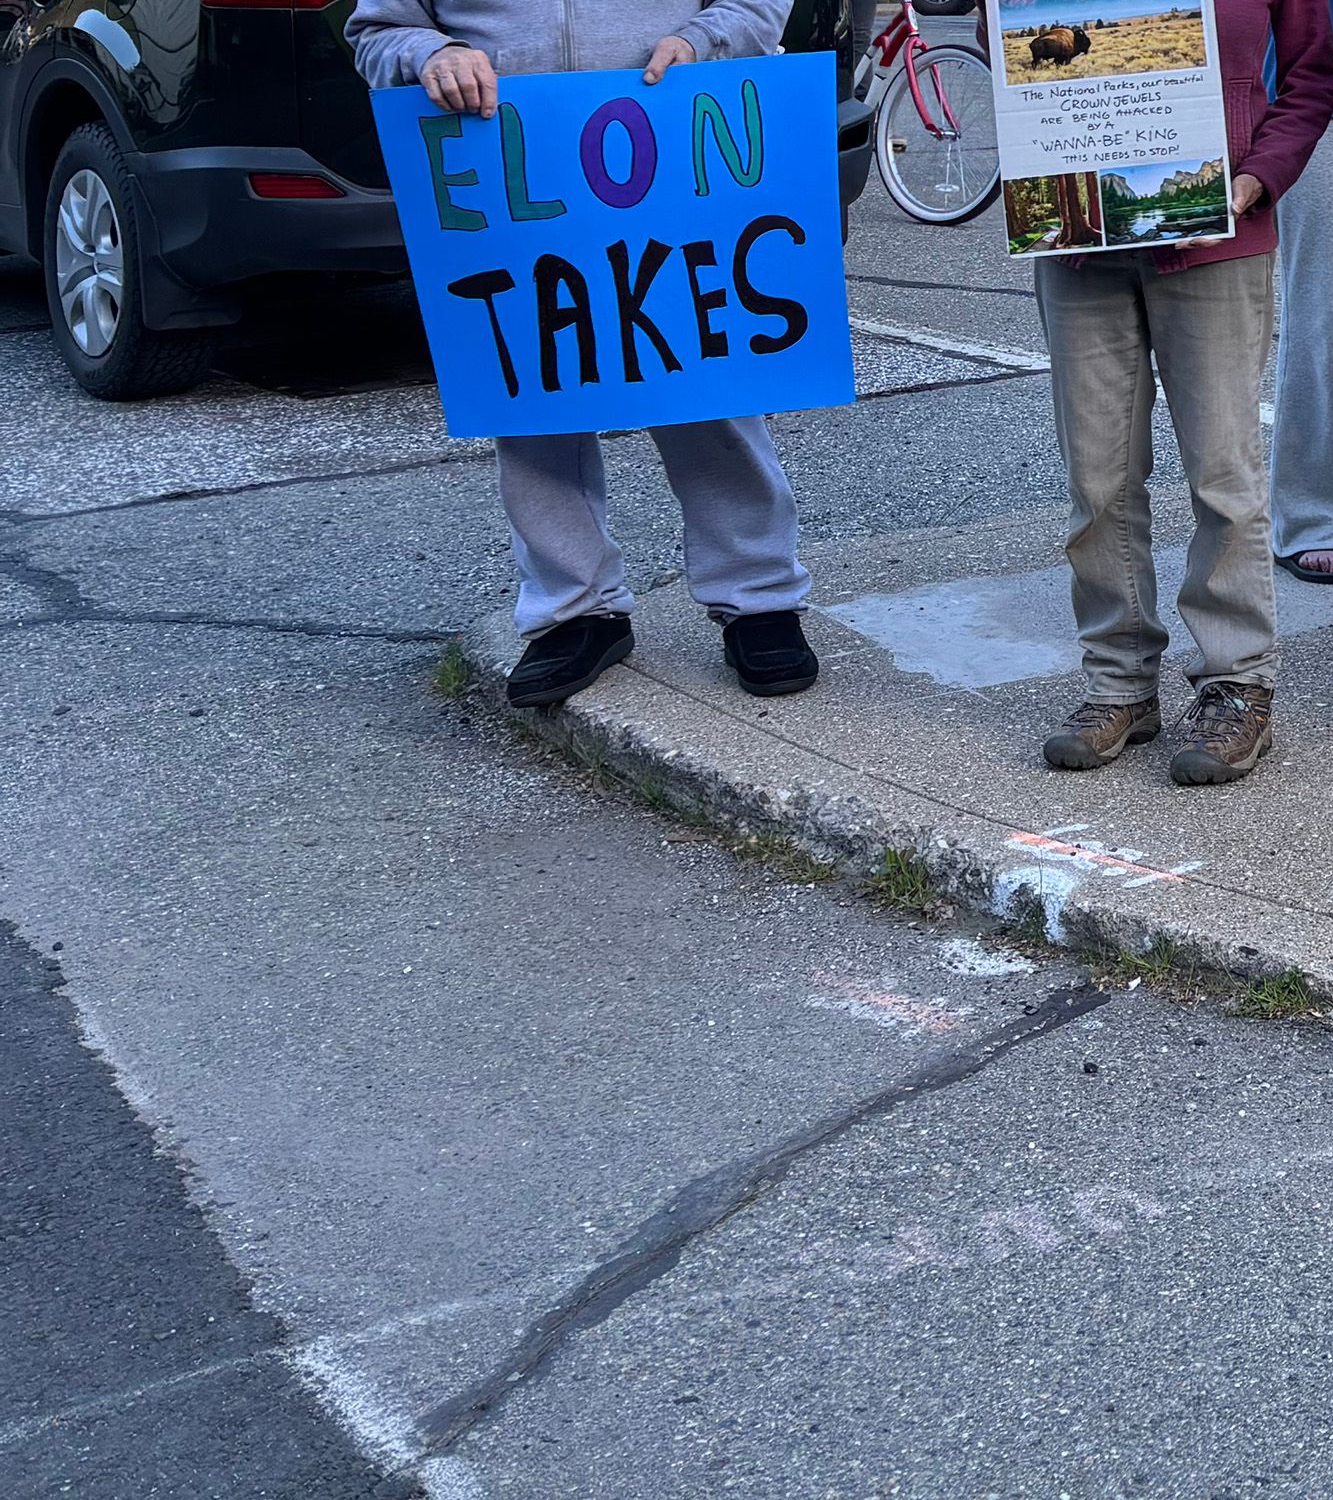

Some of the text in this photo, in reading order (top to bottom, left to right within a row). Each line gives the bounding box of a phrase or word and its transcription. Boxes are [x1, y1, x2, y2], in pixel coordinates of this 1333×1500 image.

[1021, 90, 1044, 102] The
[1050, 84, 1100, 99] National
[1104, 80, 1139, 92] Parks,
[1141, 78, 1162, 88] our
[1060, 91, 1161, 112] CROWN JEWELS
[1040, 116, 1063, 125] ARE
[1072, 111, 1110, 122] BEING
[1087, 122, 1115, 131] BY A
[1032, 125, 1178, 152] "WANNA-BE" KING
[418, 79, 764, 232] ELON
[1061, 145, 1180, 164] THIS NEEDS TO STOP!
[447, 215, 808, 398] TAKES
